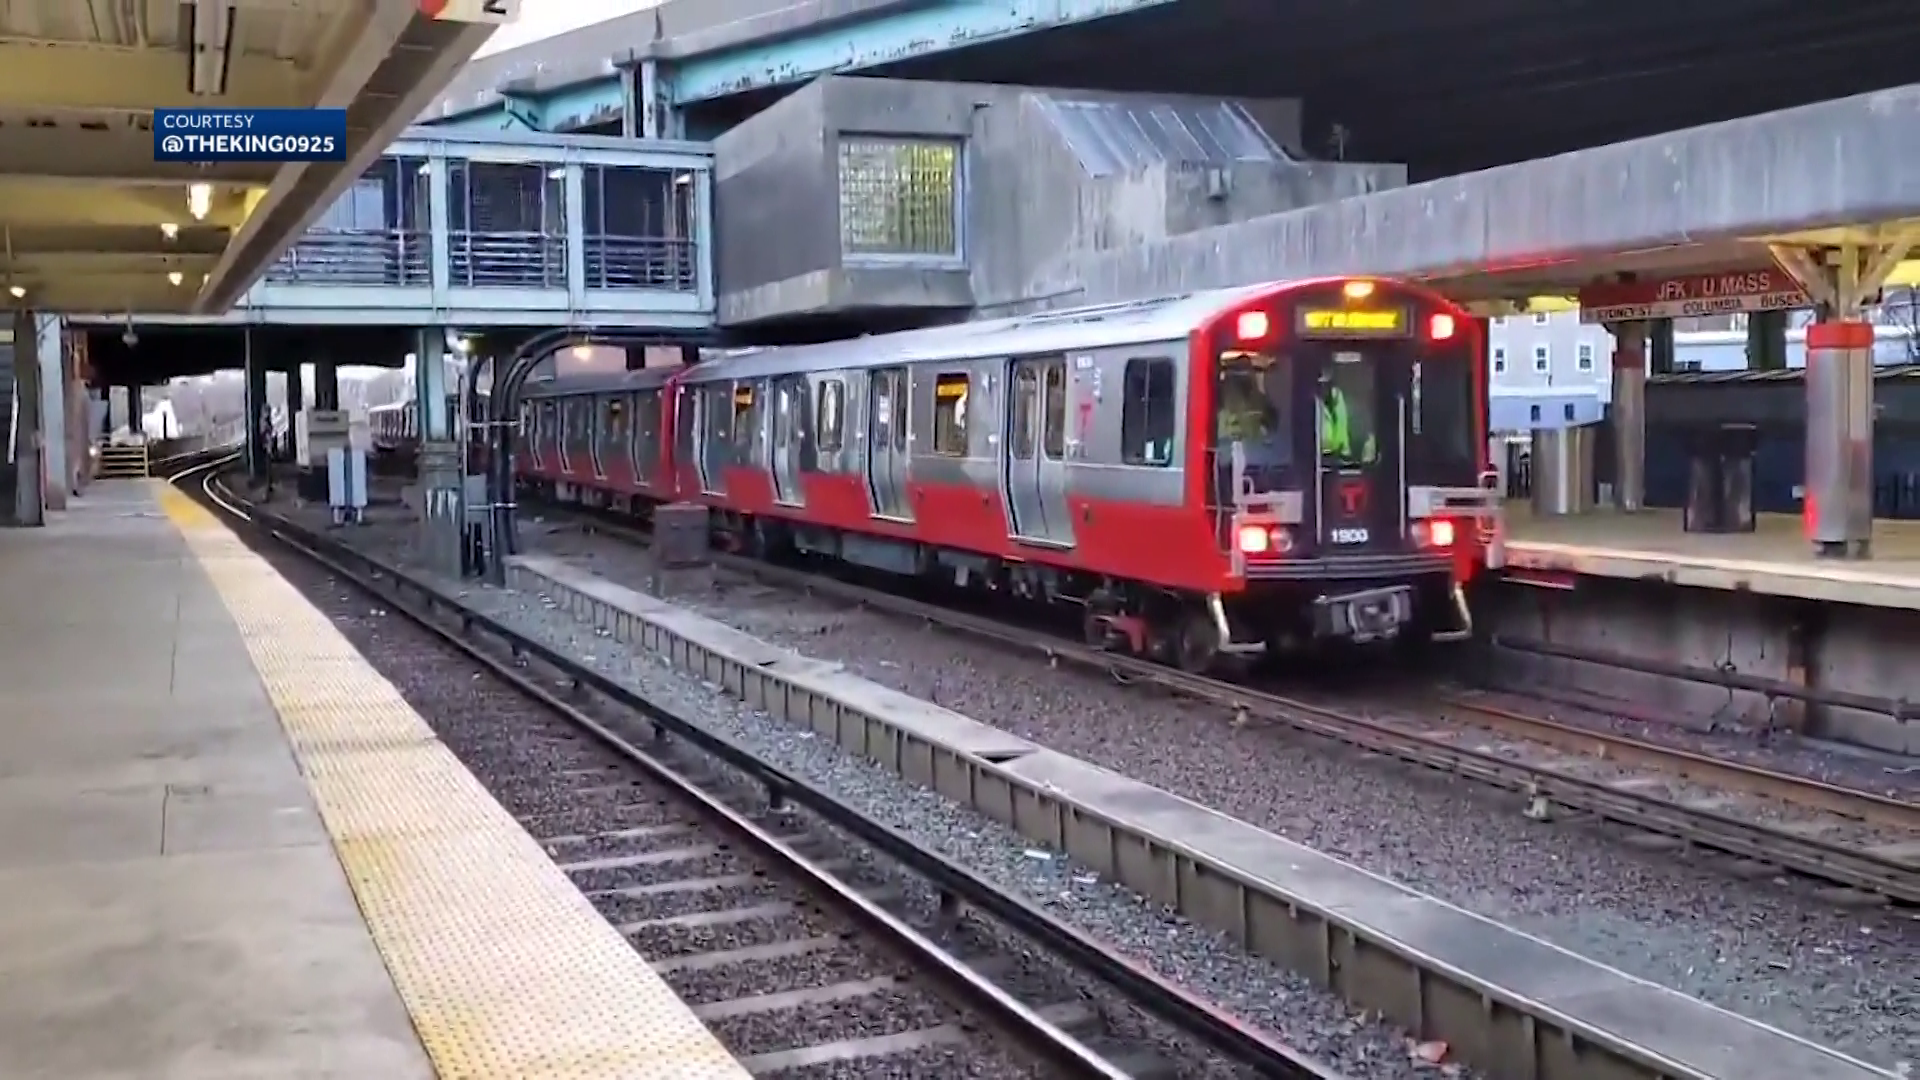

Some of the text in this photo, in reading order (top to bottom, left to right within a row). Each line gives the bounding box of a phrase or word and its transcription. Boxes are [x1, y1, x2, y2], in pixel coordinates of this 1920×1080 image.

[1656, 281, 1686, 300] JFK
[1702, 282, 1716, 296] U
[1720, 273, 1771, 294] MASS
[1683, 298, 1743, 314] COLUMBIA
[1760, 294, 1803, 308] BUSES
